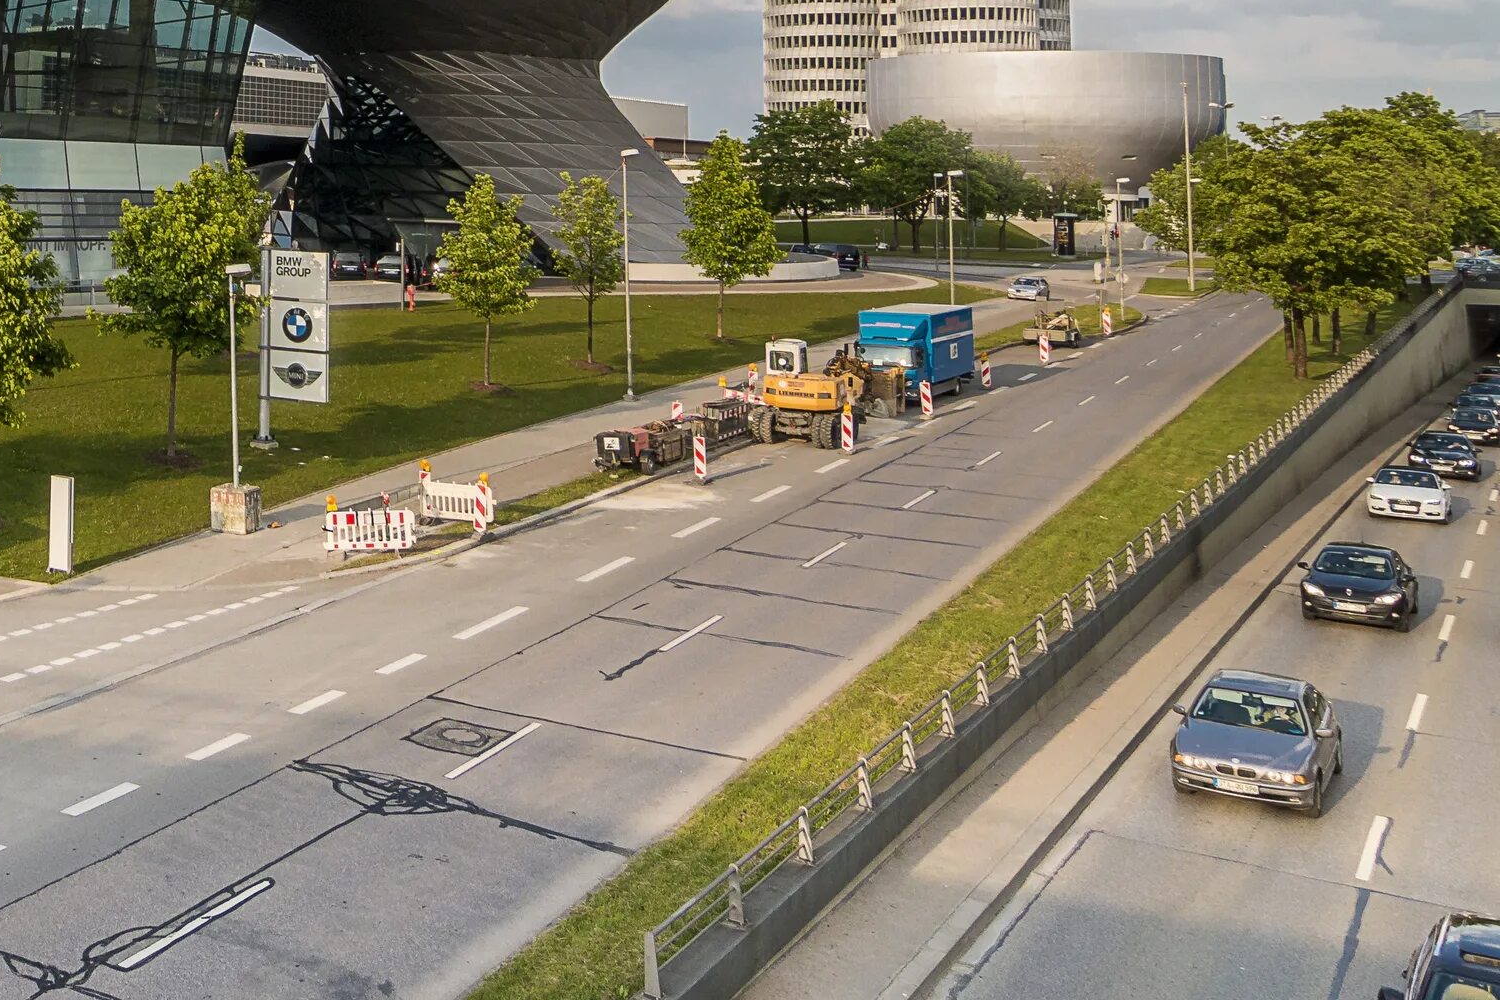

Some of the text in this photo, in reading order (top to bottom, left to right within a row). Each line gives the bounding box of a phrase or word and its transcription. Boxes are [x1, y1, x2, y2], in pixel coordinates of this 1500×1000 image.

[276, 256, 302, 267] BMW
[275, 267, 311, 278] GROUP
[288, 371, 304, 380] MINI
